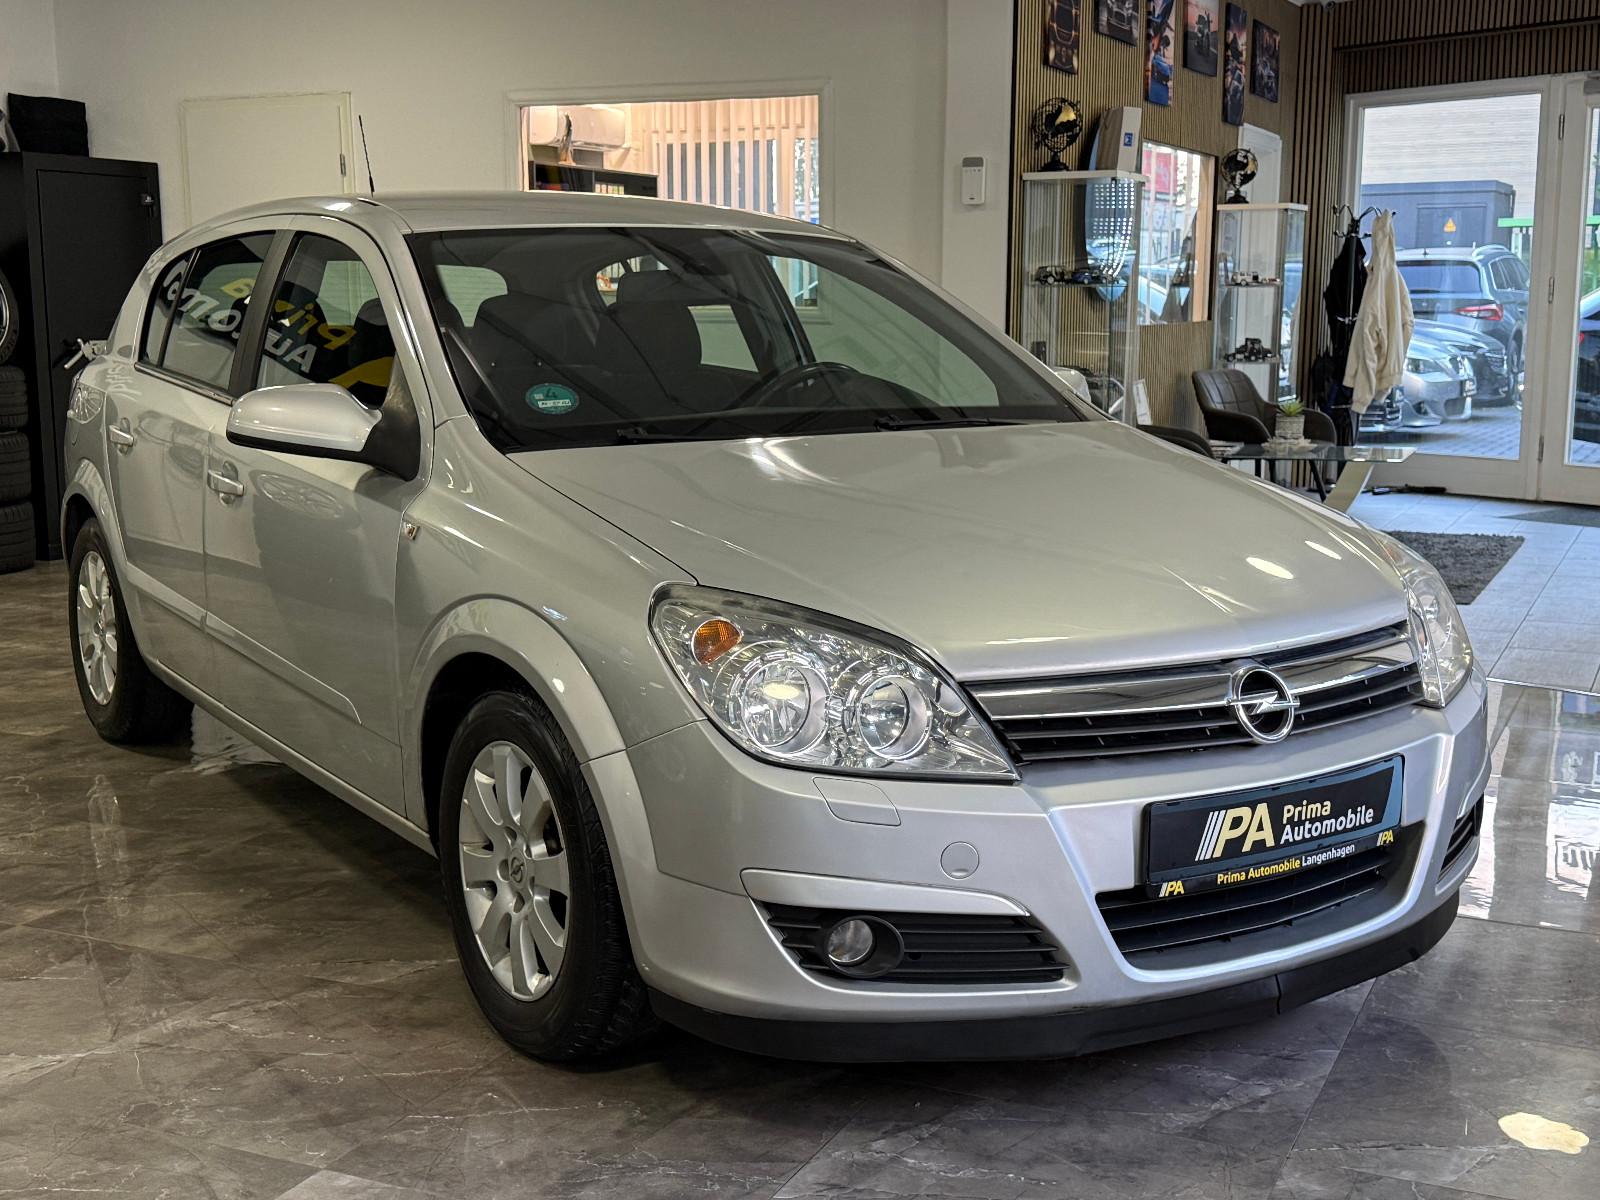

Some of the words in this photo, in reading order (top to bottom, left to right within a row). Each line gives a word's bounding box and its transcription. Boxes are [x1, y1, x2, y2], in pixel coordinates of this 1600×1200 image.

[1212, 802, 1275, 858] PA
[1280, 806, 1374, 844] Automobile
[1283, 800, 1331, 824] Prima
[1217, 871, 1246, 885] Prima
[1248, 858, 1301, 880] Automobile
[1302, 844, 1355, 867] Langenhagen
[1165, 880, 1185, 896] PA
